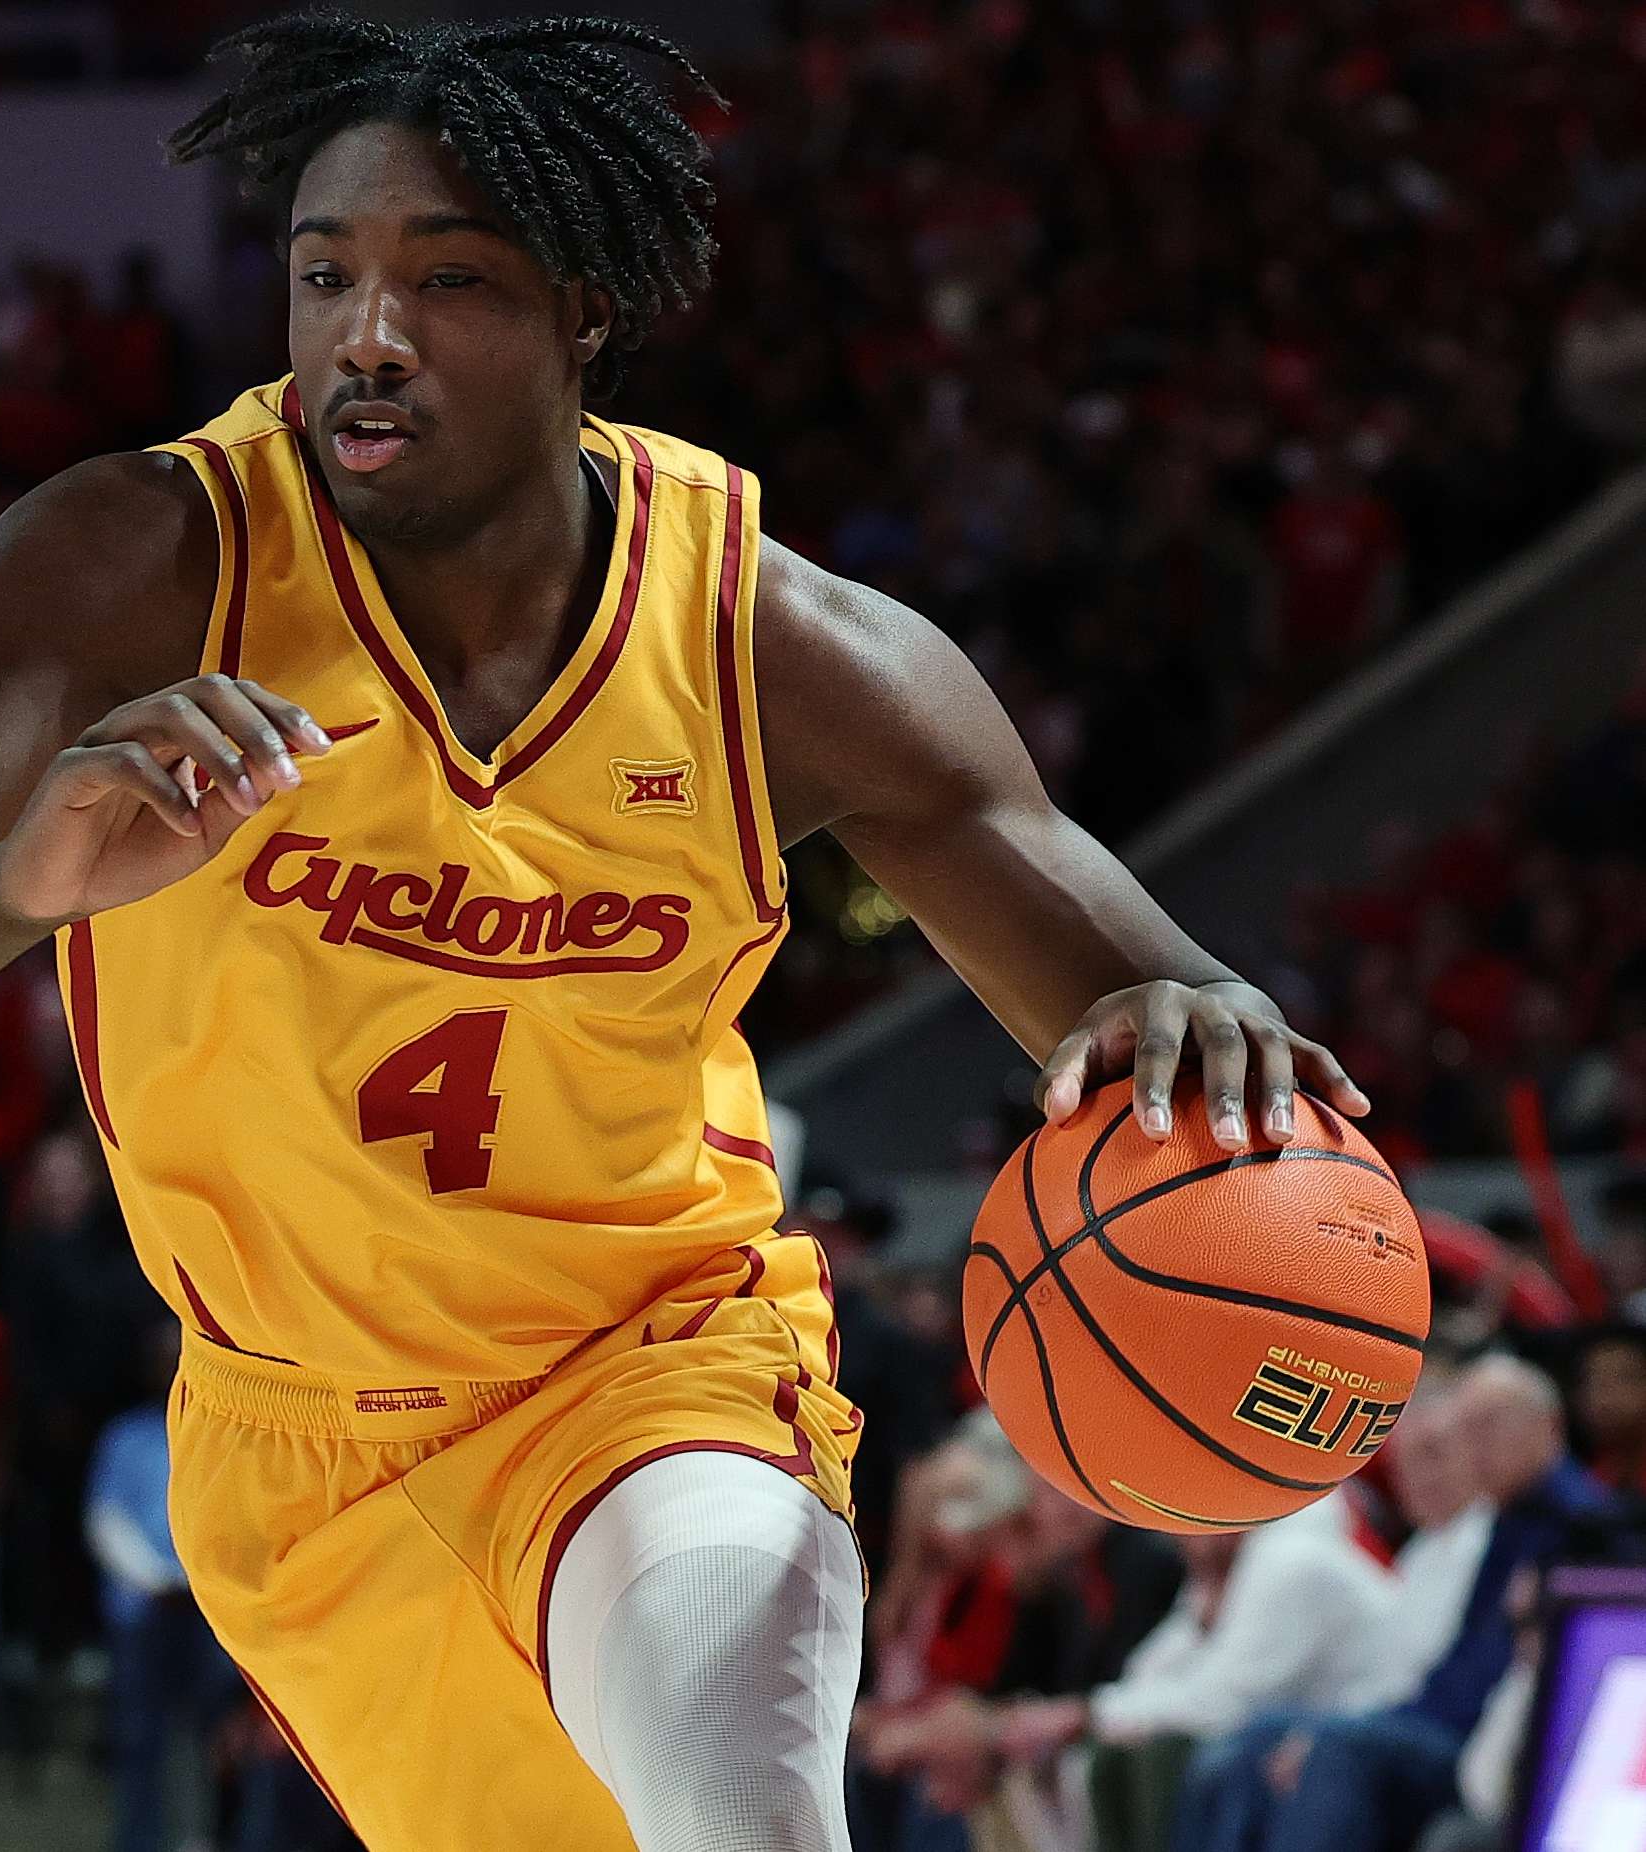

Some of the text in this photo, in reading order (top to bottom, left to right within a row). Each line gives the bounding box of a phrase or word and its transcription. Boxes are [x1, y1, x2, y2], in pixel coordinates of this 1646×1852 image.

[625, 770, 687, 804] XII
[243, 831, 692, 980] Cyclones
[357, 1008, 508, 1196] 4
[355, 1401, 401, 1412] HILTON
